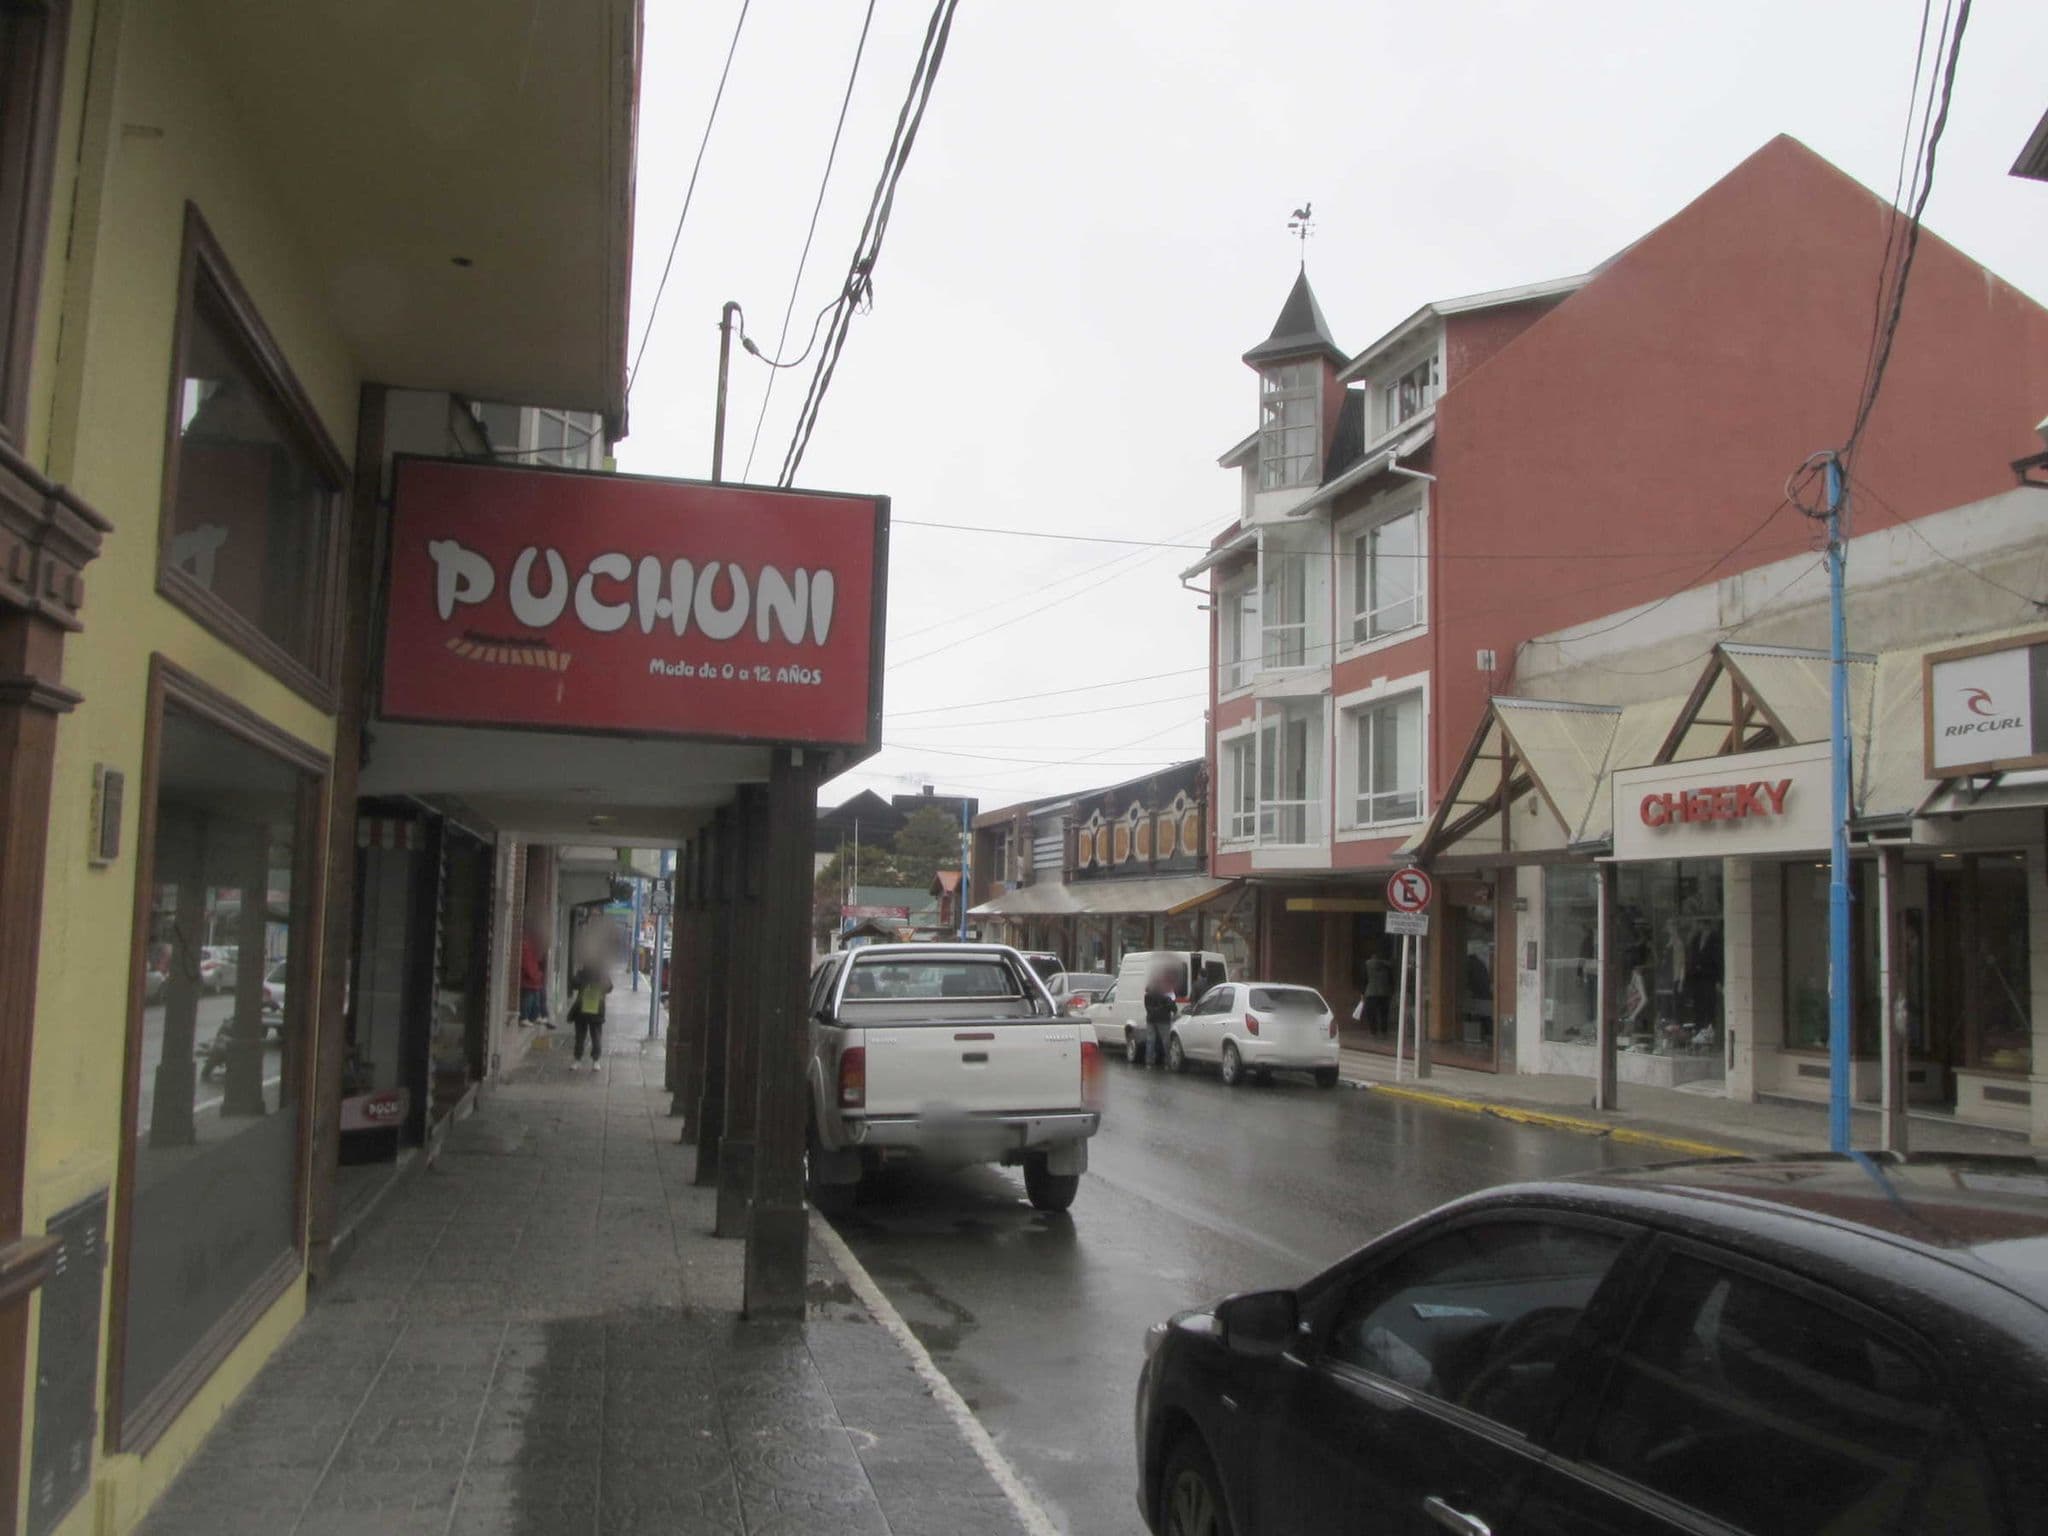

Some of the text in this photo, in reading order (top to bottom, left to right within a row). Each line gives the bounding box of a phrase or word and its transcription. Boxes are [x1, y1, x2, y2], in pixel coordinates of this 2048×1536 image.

[428, 539, 835, 647] PUCHUNI
[649, 658, 694, 677] Moda
[699, 662, 717, 679] de
[739, 668, 749, 681] a
[753, 665, 771, 682] 12
[776, 664, 822, 685] AÑOS
[1945, 717, 2025, 737] RIP CURL
[1640, 778, 1793, 828] CHEEKY
[656, 880, 666, 891] E
[1403, 879, 1418, 903] E
